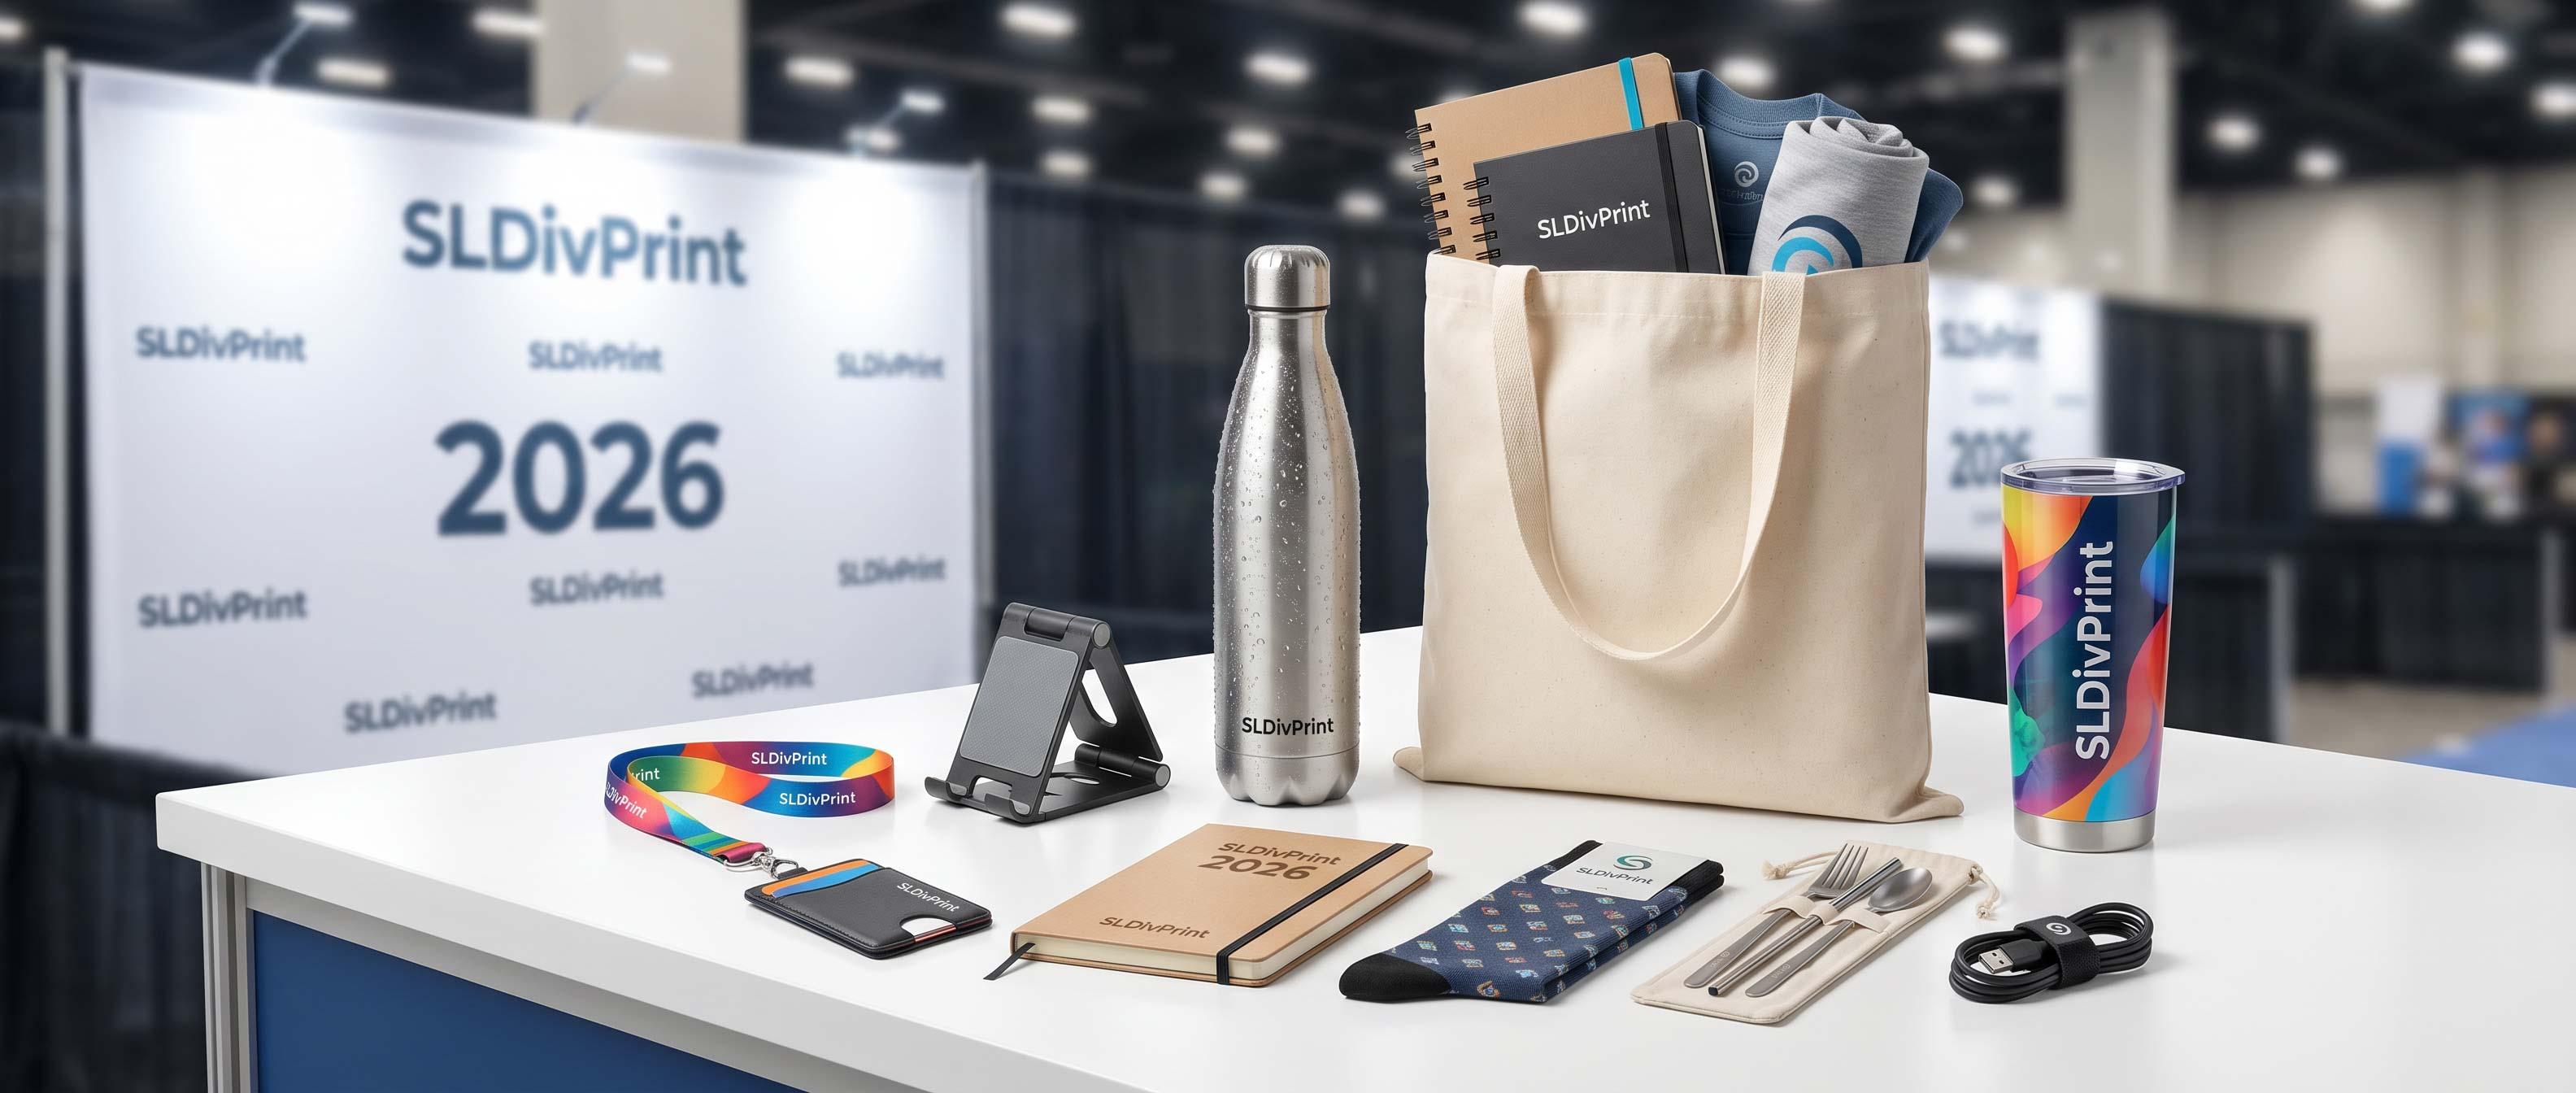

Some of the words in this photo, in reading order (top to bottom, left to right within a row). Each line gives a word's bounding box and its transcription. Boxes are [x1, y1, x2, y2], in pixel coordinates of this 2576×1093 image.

[1537, 199, 1651, 239] SLDivPrint
[402, 198, 747, 286] SLDivPrint
[136, 325, 305, 361] SLDivPrint
[529, 340, 663, 372] SLDivPrint
[838, 352, 945, 379] SLDivPrint
[435, 420, 724, 537] 2026
[838, 556, 946, 587] SLDivPrint
[529, 572, 664, 607] SLDivPrint
[137, 590, 307, 629] SLDivPrint
[2072, 541, 2113, 760] SLDivPrint
[691, 663, 814, 698] SLDivPrint
[344, 693, 496, 734] SLDivPrint
[1242, 716, 1334, 736] SLDivPrint
[751, 751, 828, 766] SLDivPrint
[779, 791, 856, 806] SLDivPrint
[1198, 854, 1318, 881] 2026
[1217, 843, 1342, 865] SLDivPrint
[1576, 867, 1654, 885] SLDivPrint
[897, 882, 961, 912] SLDivPrint
[1099, 917, 1211, 940] SLDivPrint
